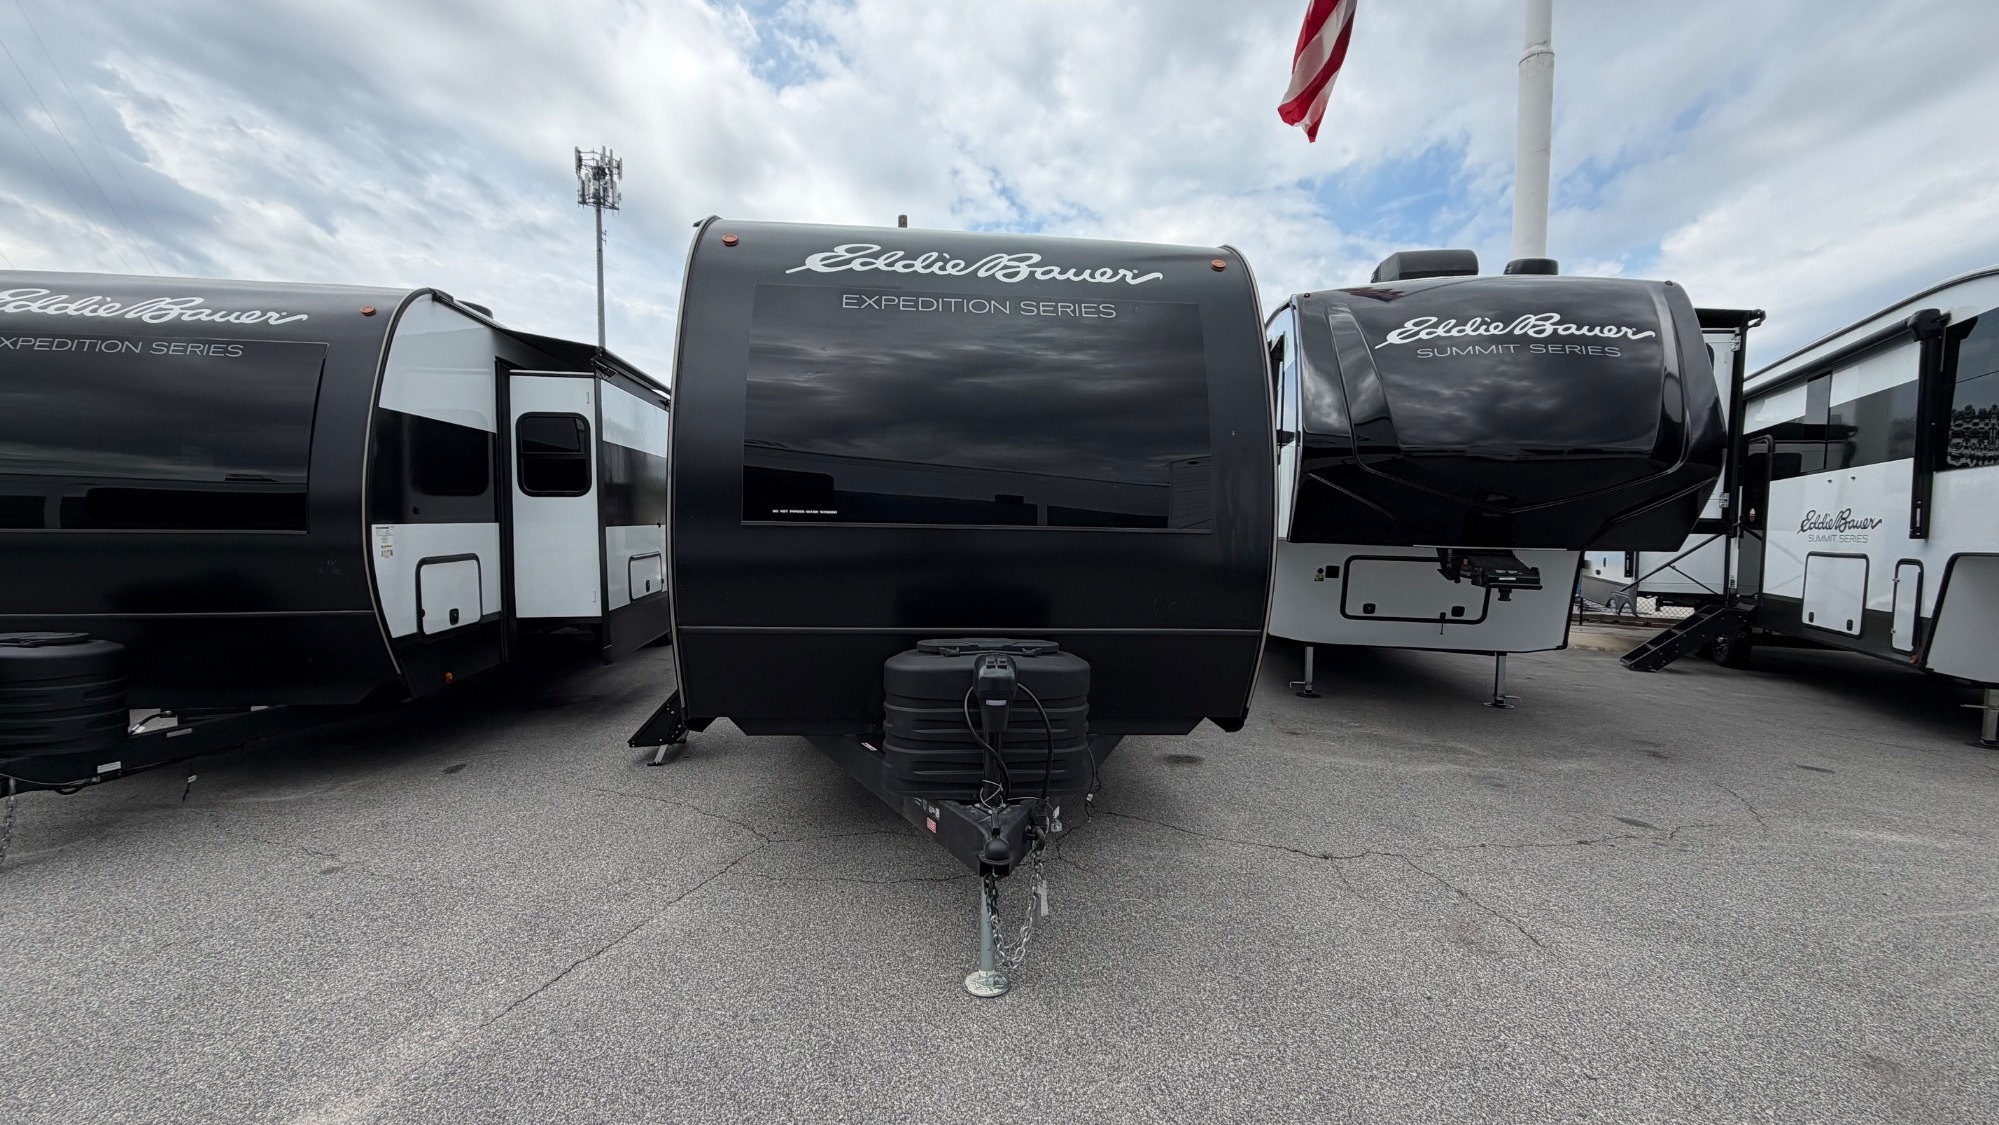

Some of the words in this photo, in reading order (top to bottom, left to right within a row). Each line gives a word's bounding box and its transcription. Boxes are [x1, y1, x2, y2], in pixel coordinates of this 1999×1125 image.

[786, 243, 978, 276] Eddie
[977, 253, 1163, 285] Bauer
[124, 297, 309, 326] Bauer
[842, 294, 1010, 315] EXPEDITION
[1020, 301, 1117, 319] SERIES
[1375, 316, 1513, 350] Eddie
[1512, 312, 1656, 341] Bauer
[0, 336, 143, 354] XPEDITION
[151, 342, 245, 358] SERIES
[1417, 344, 1520, 359] SUMMIT
[1529, 343, 1621, 358] SERIES
[1796, 509, 1835, 535] Eddie
[1834, 507, 1882, 533] Bauer
[1808, 534, 1837, 543] SUMMIT
[1838, 534, 1869, 544] SERIES
